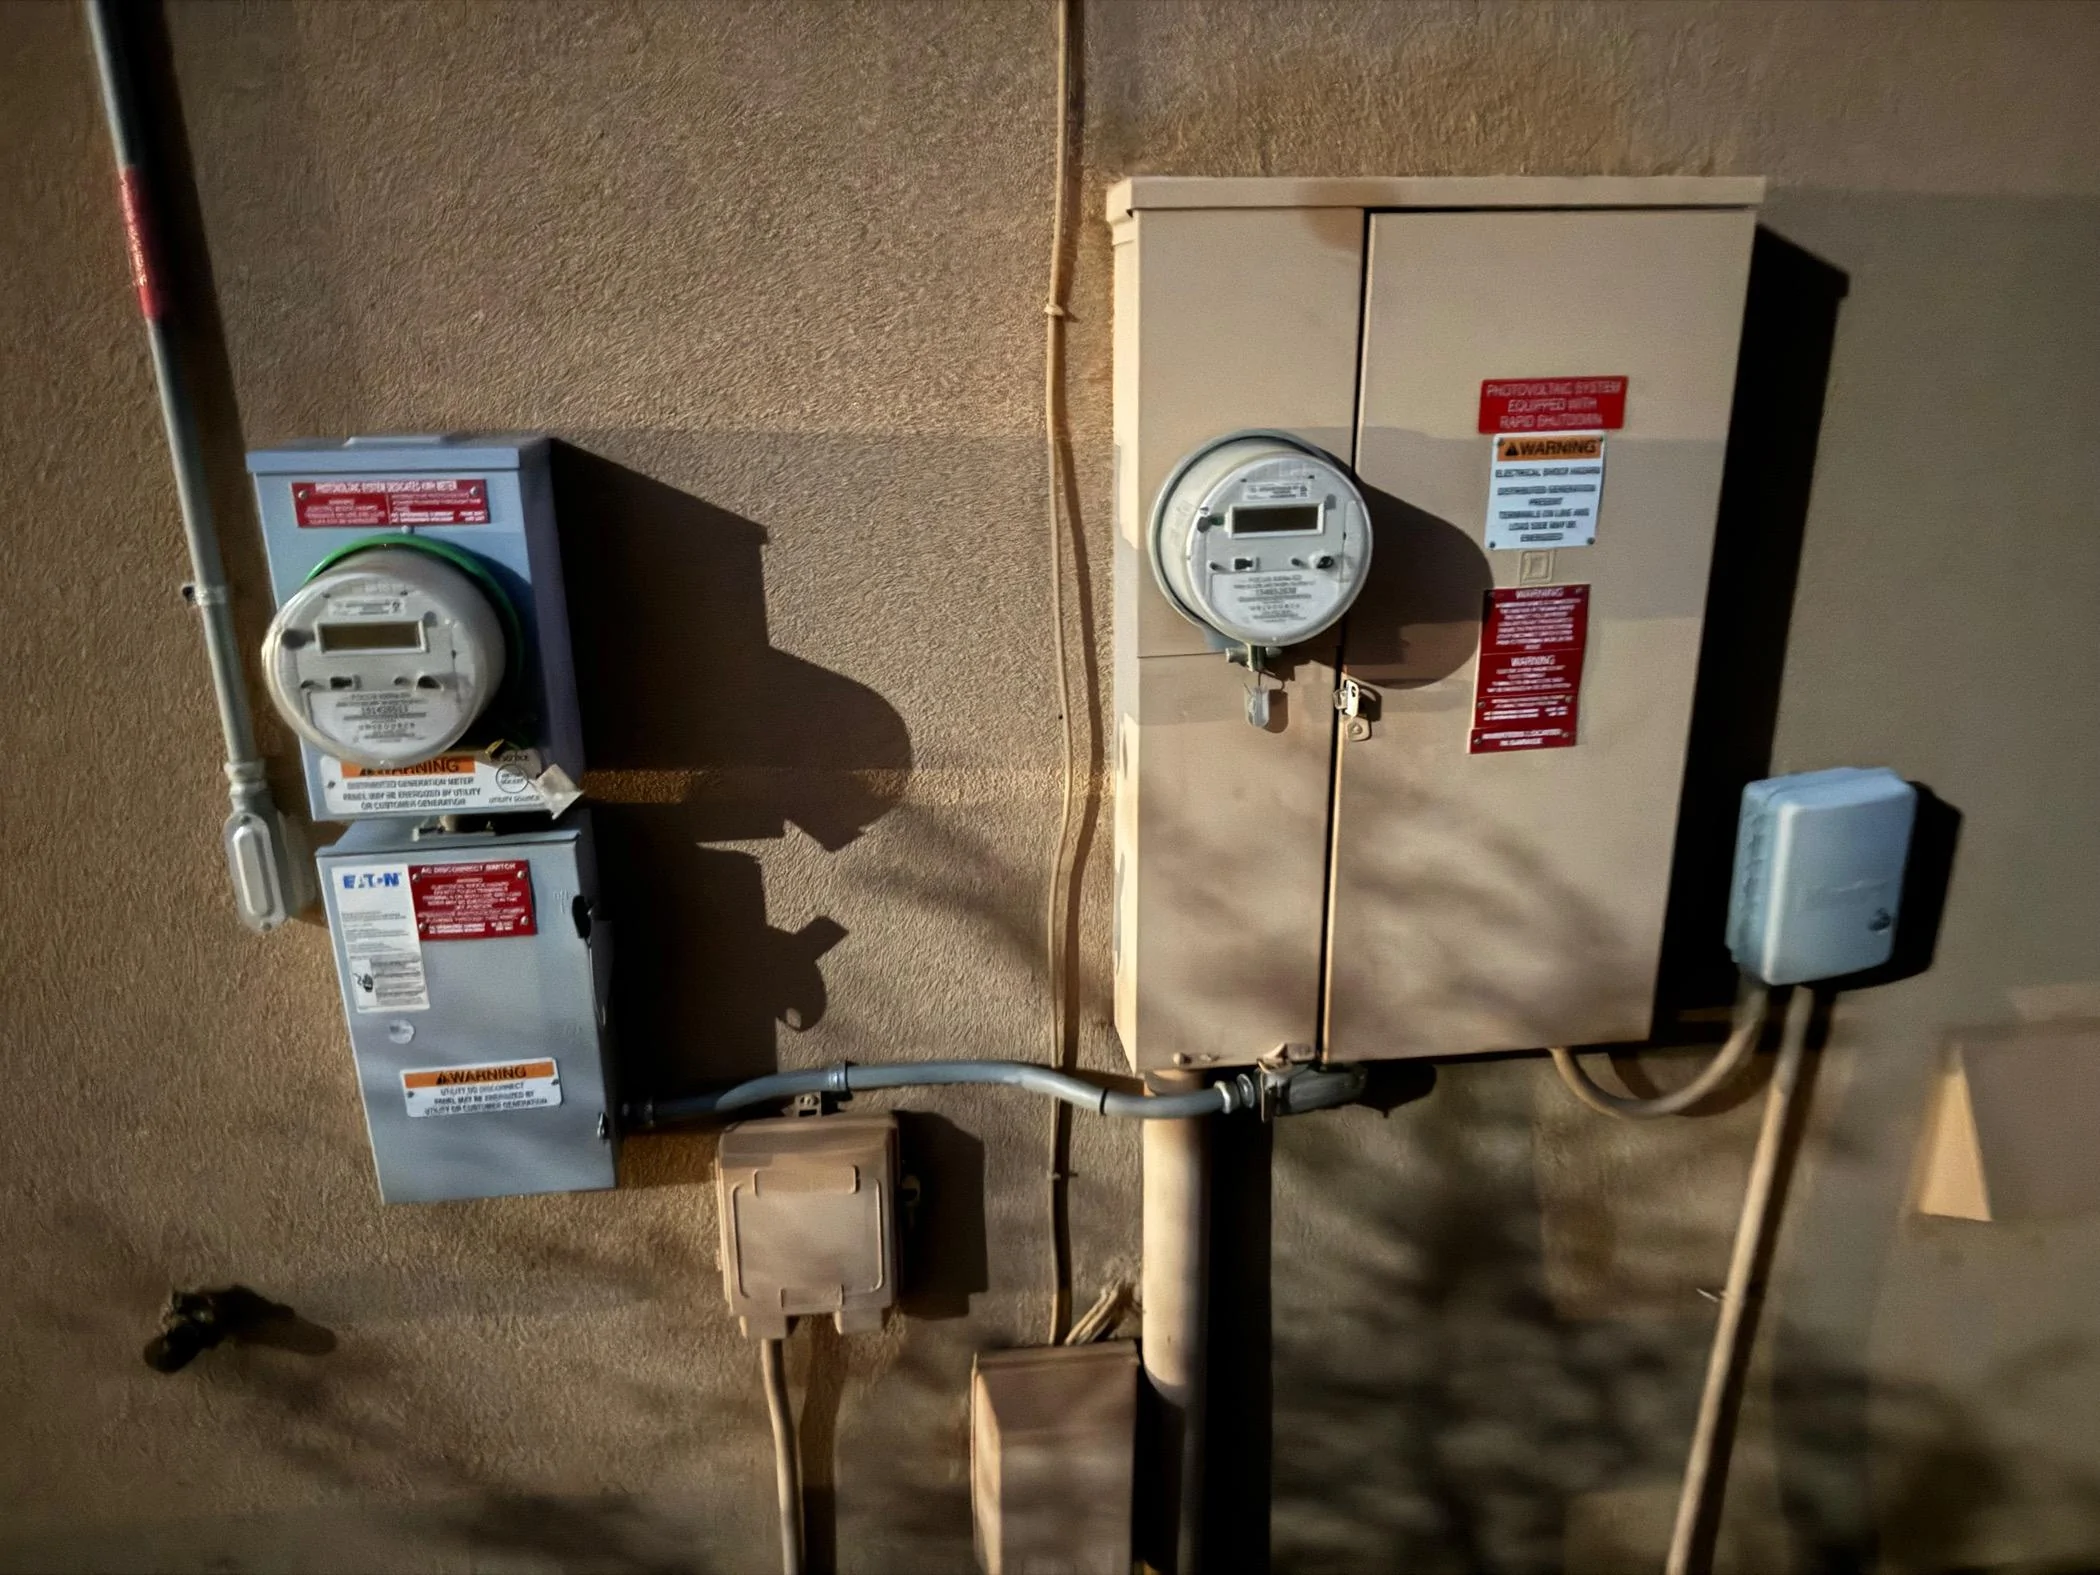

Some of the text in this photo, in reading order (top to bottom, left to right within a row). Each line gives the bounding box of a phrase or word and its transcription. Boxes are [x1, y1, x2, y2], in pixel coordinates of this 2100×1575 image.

[1500, 415, 1533, 427] RAPID
[1521, 440, 1596, 455] WARNING
[1511, 655, 1555, 666] WARNING
[448, 777, 474, 785] METER
[454, 788, 481, 796] UTILITY
[448, 1067, 526, 1084] WARNING
[441, 1087, 466, 1096] UTILITY
